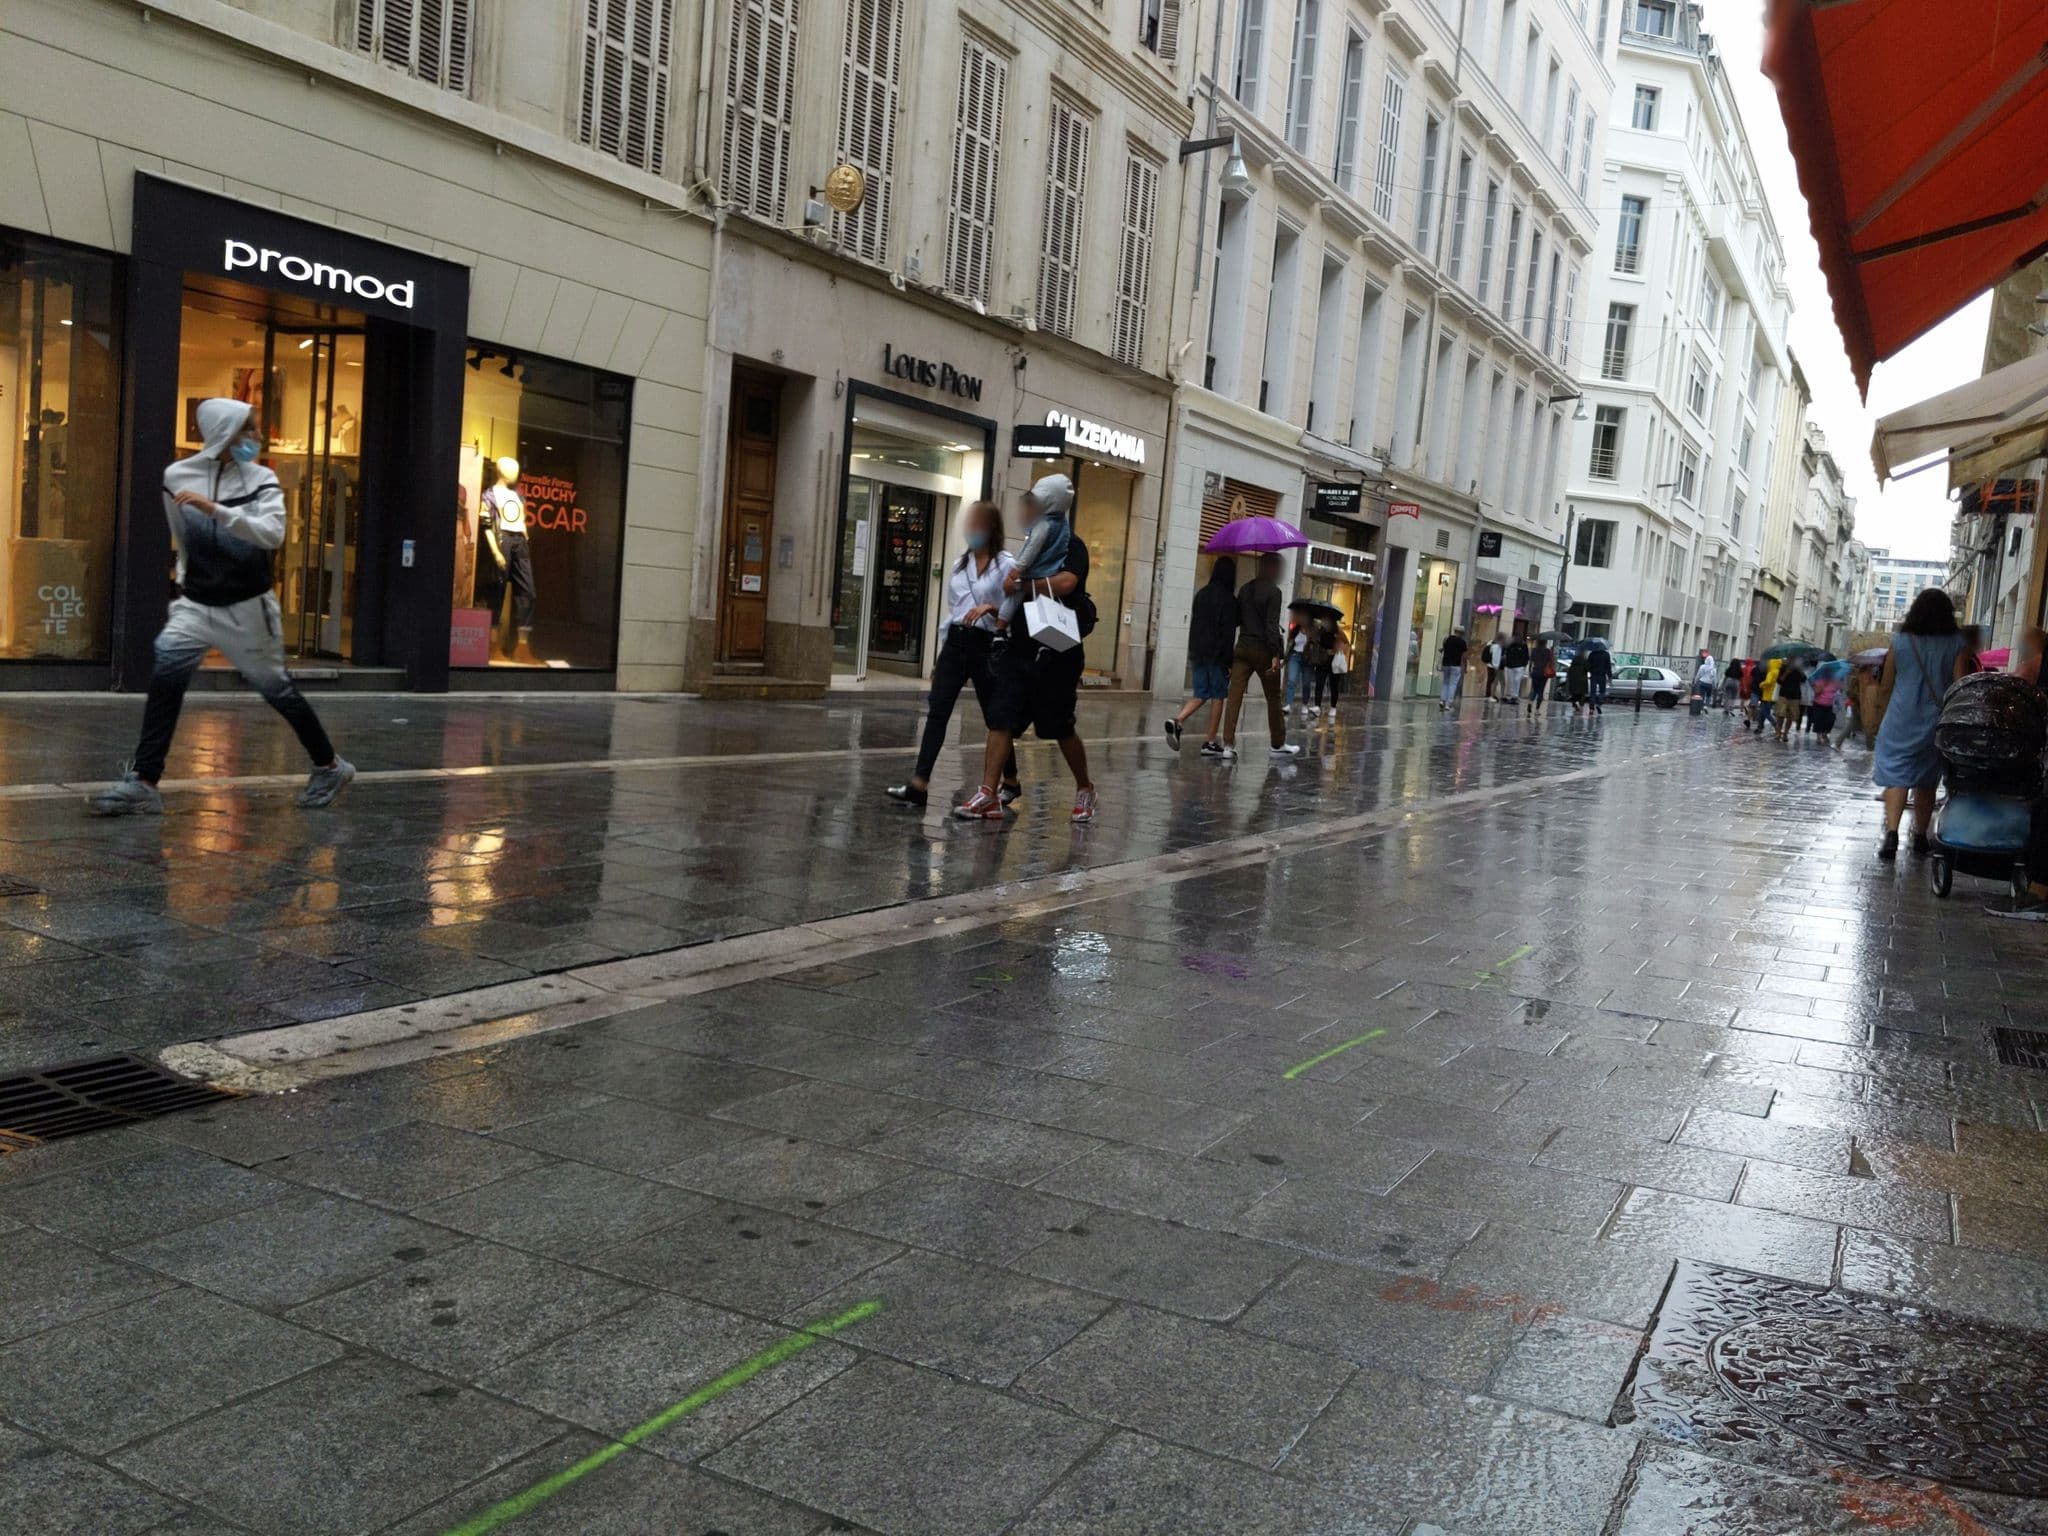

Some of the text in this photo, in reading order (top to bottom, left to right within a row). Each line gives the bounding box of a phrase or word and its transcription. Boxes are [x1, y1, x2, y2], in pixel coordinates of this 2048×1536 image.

[224, 239, 415, 309] promod
[884, 343, 983, 402] LOUIS PION
[1046, 410, 1146, 464] CALZEDONIA
[38, 585, 82, 601] COL
[41, 619, 69, 635] TE
